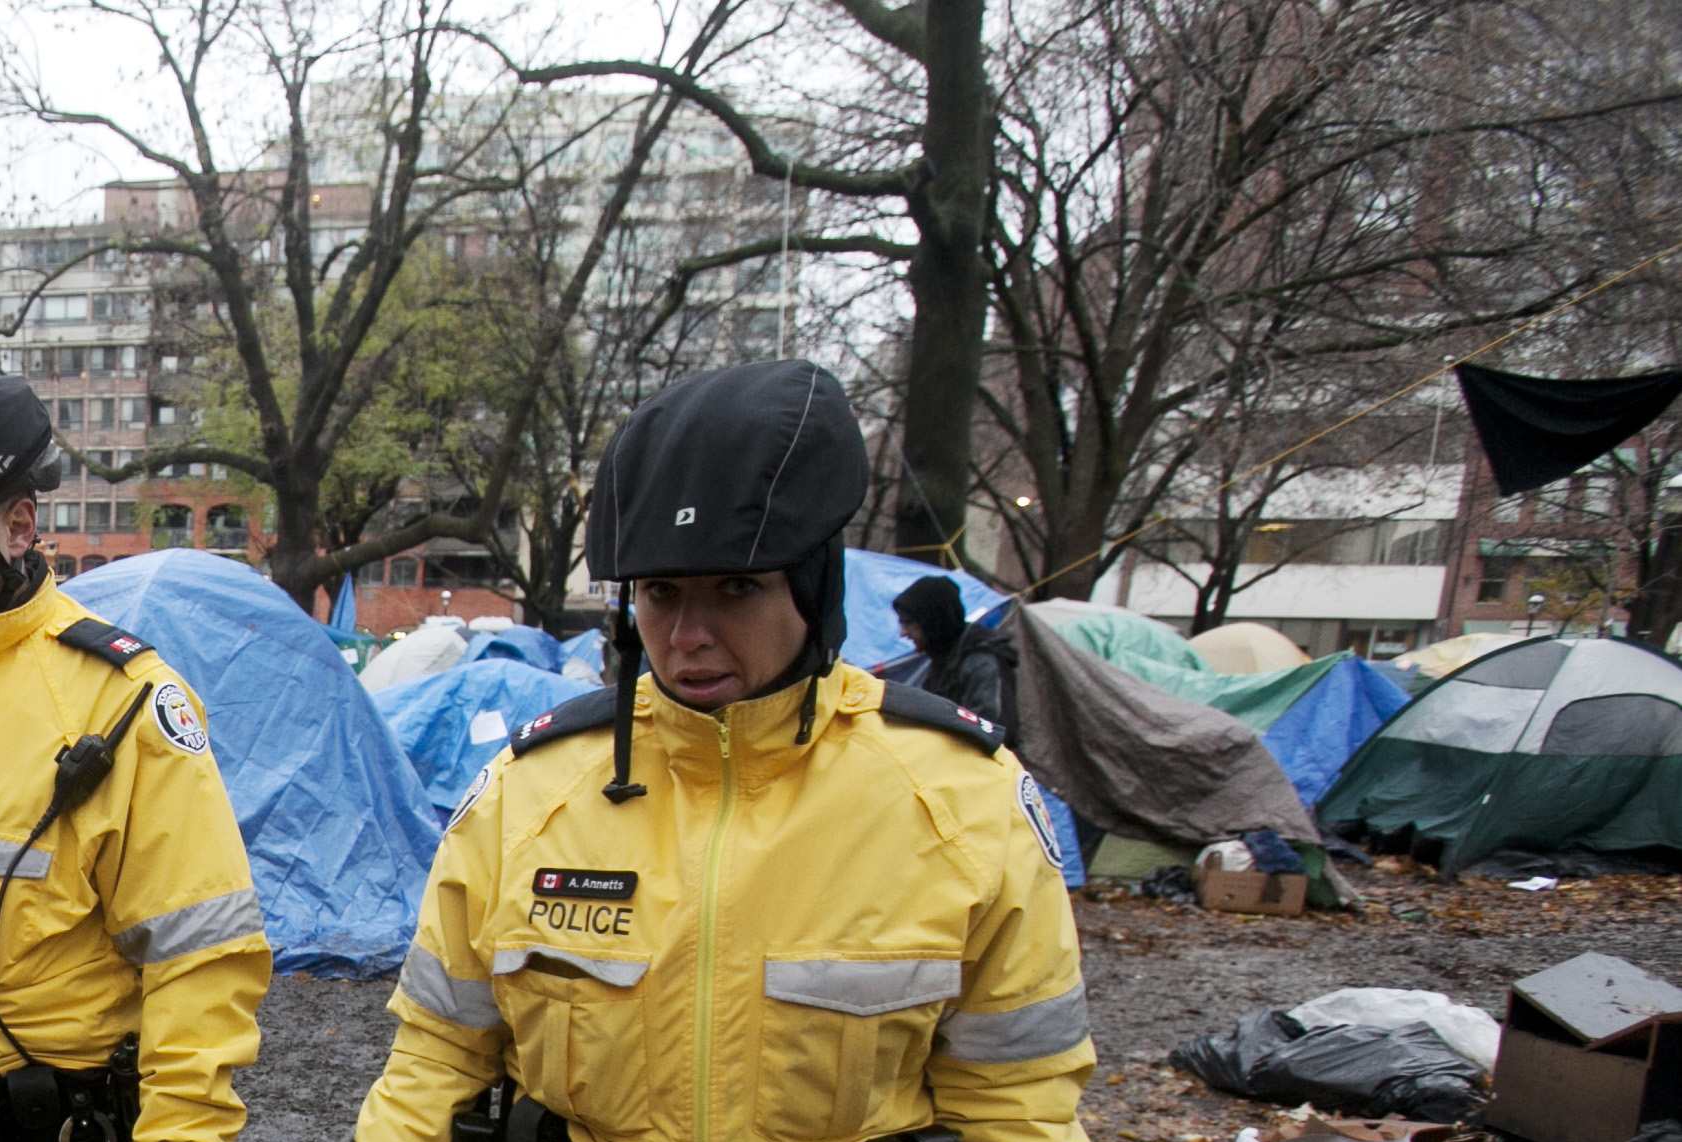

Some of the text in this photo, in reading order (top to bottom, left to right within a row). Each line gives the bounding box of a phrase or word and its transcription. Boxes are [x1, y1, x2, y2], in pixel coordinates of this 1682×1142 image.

[568, 878, 625, 891] A. Annetts
[528, 900, 634, 936] POLICE
